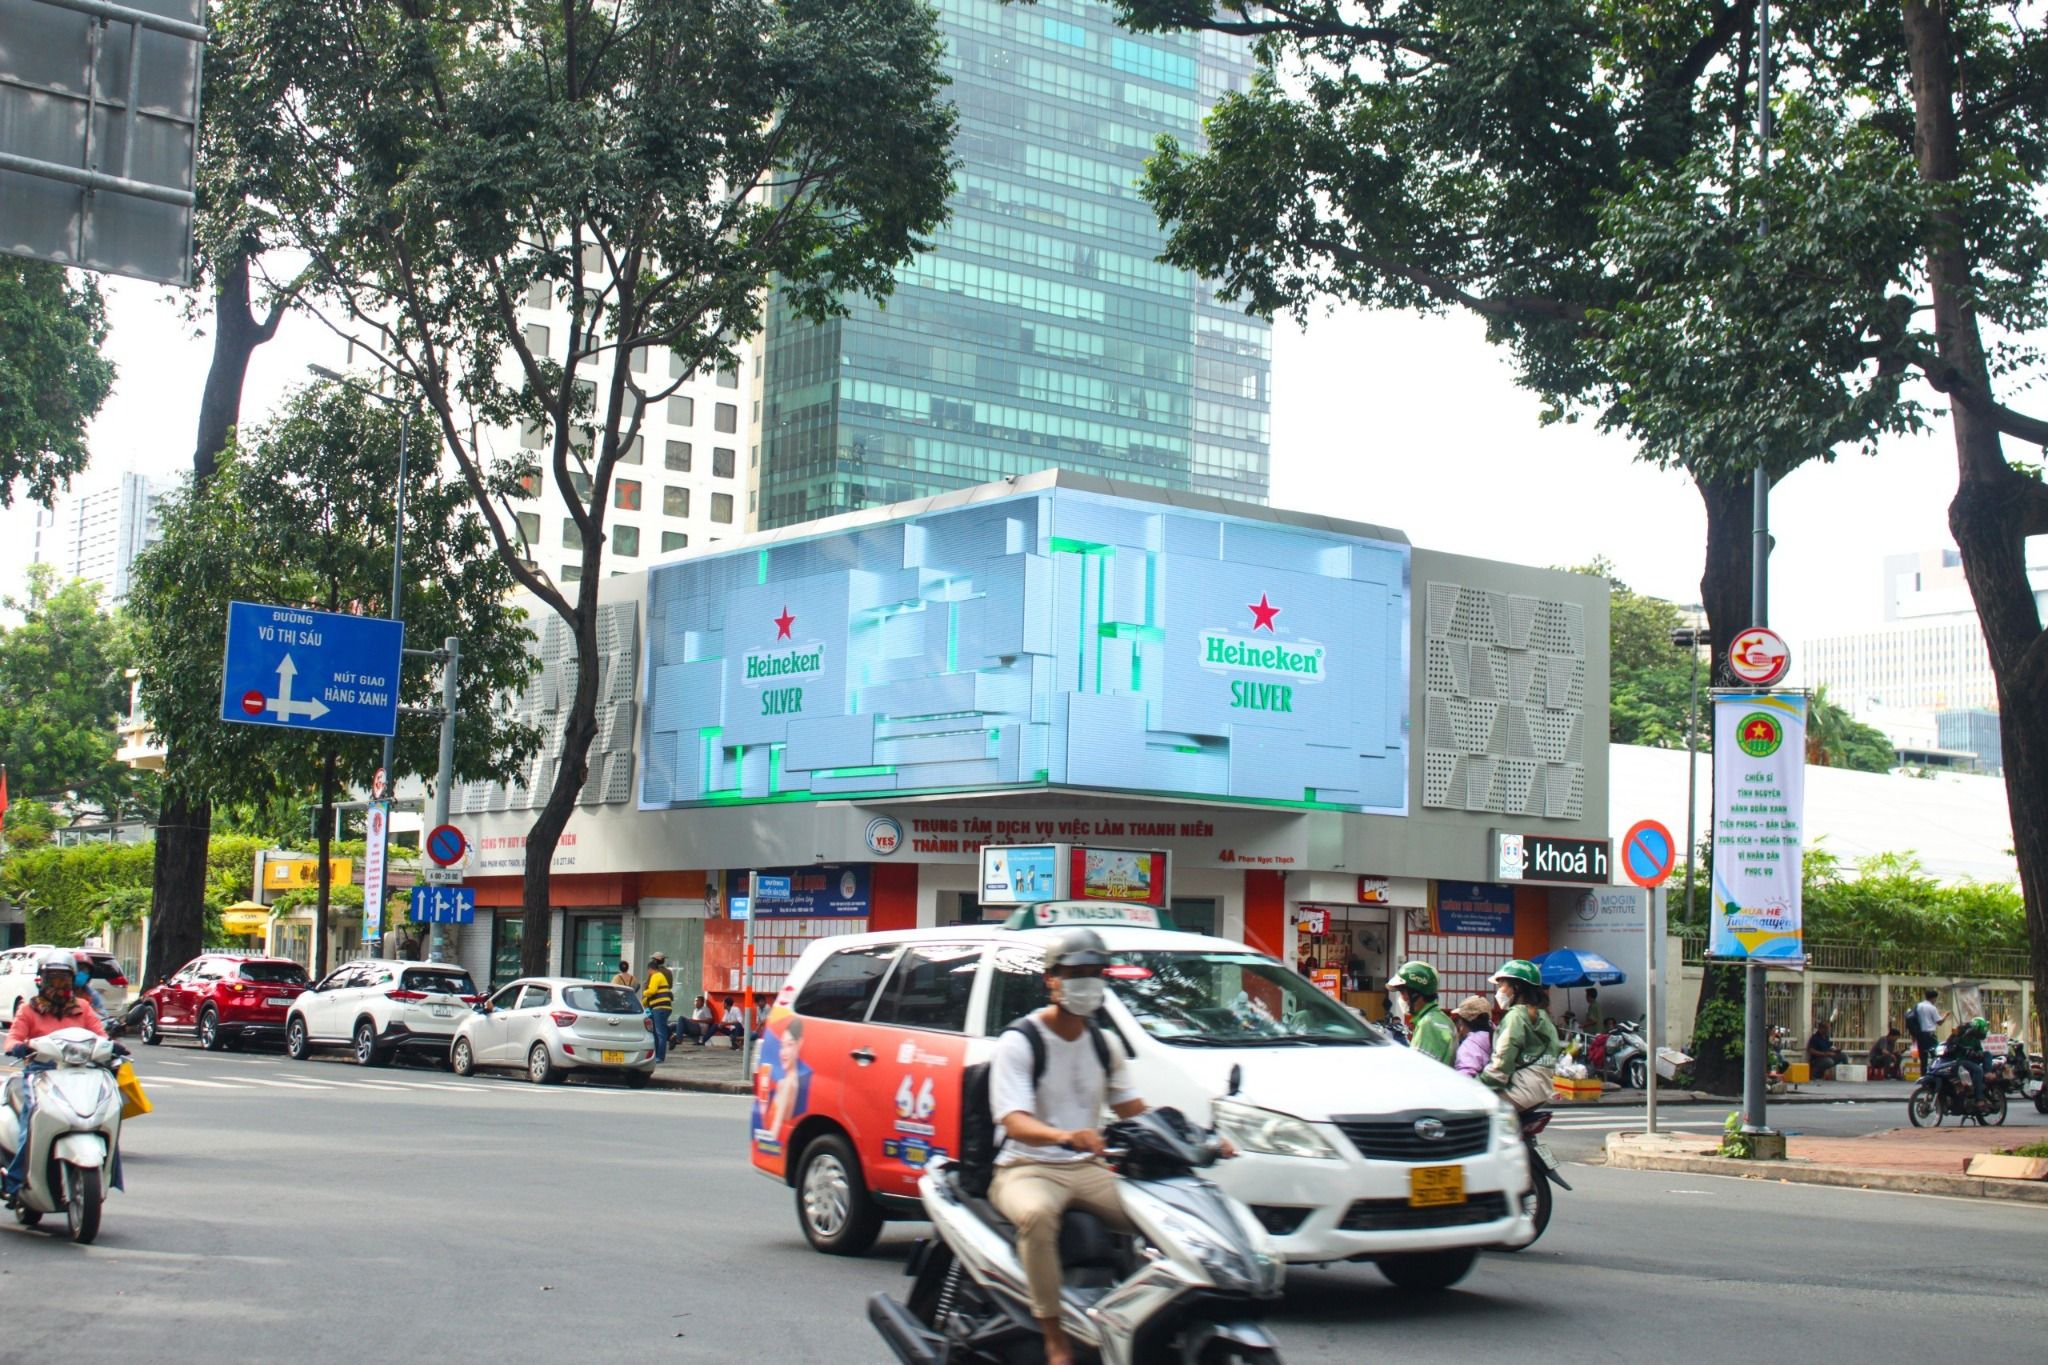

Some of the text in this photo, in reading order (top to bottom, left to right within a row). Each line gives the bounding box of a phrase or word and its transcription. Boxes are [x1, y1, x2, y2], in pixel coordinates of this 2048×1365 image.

[272, 611, 313, 625] ĐƯỜNG
[258, 625, 323, 647] VÕ THỊ SÁU
[1206, 636, 1318, 674] Heineken
[746, 650, 820, 679] Heineken
[333, 671, 385, 687] NÚT GIAO
[324, 685, 388, 707] HÀNG XANH
[761, 687, 803, 716] SILVER
[1230, 680, 1293, 712] SILVER
[1770, 805, 1788, 814] XANH
[912, 816, 1214, 840] TRUNG TÂM DỊCH VỤ VIỆC LÀM THANH NIÊN
[1736, 821, 1757, 829] PHONG
[480, 836, 497, 850] CÔNG
[498, 837, 506, 849] TY
[560, 833, 577, 846] NIÊN
[876, 837, 894, 847] YES
[912, 834, 959, 853] THÀNH
[1218, 849, 1236, 862] 4A
[1257, 855, 1273, 864] Ngọc
[1275, 855, 1295, 864] Thạch
[1535, 842, 1587, 874] khoá
[1594, 847, 1607, 875] h
[1106, 885, 1128, 898] 2022
[1601, 895, 1636, 905] MOGIN
[1601, 905, 1636, 915] INSTITUTE
[1408, 973, 1429, 986] Grab
